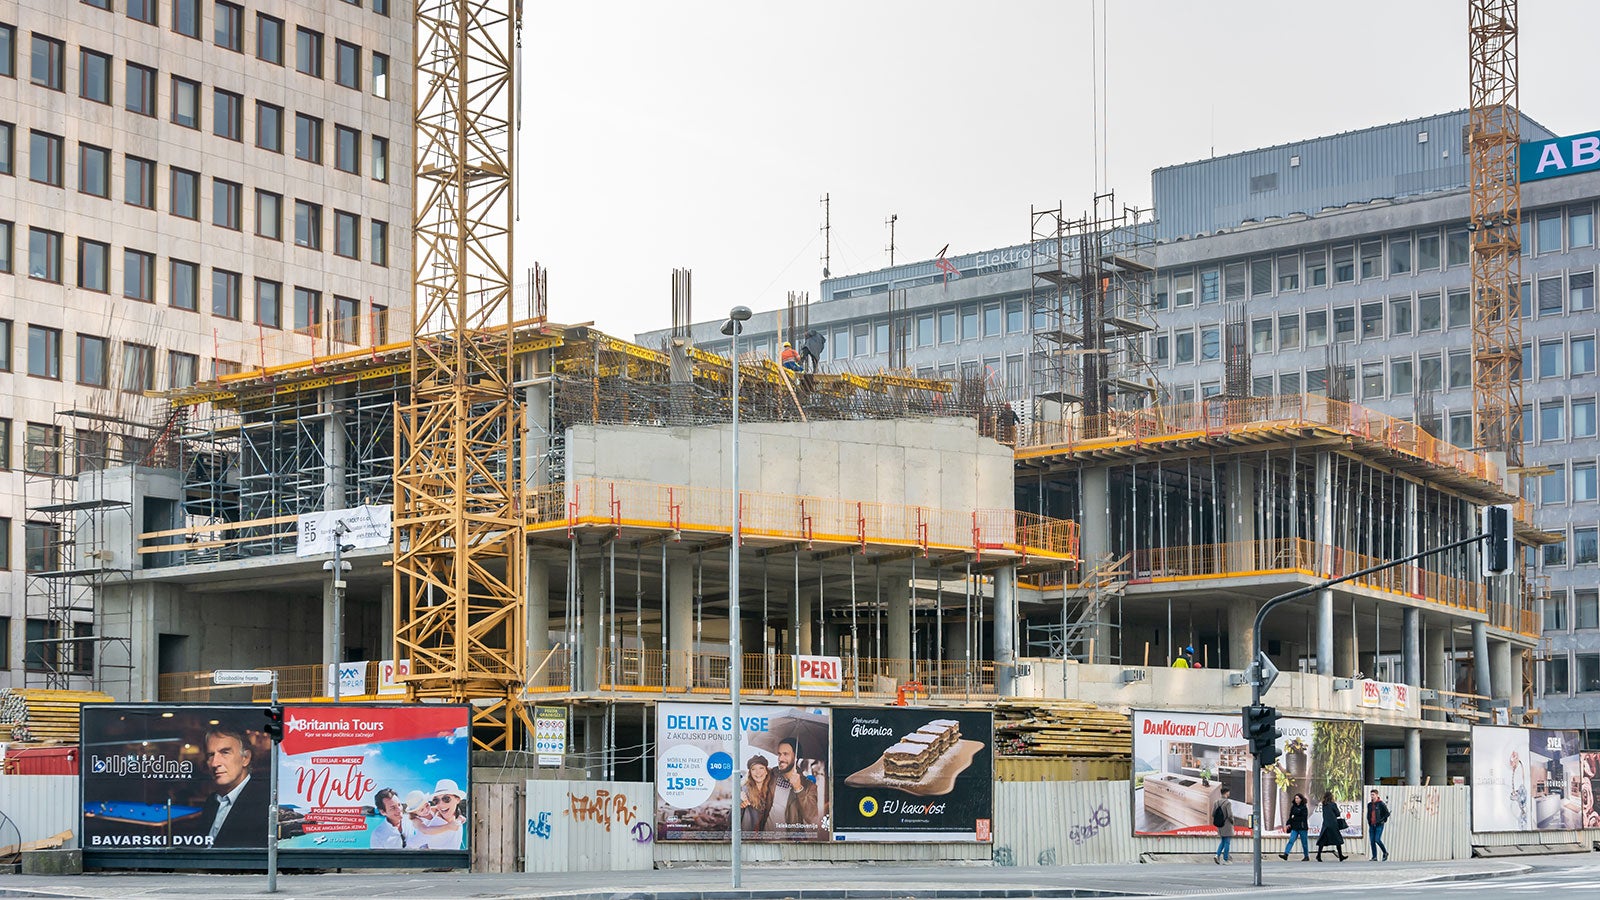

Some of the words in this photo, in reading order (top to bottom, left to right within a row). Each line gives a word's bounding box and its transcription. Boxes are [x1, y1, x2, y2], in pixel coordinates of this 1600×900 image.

[976, 248, 1031, 266] Elektro
[800, 660, 837, 679] PERI
[300, 719, 349, 730] Britannia
[352, 719, 384, 730] Tours
[667, 715, 718, 730] DELITA
[740, 717, 769, 732] VSE
[851, 724, 893, 737] Gibanica
[92, 755, 193, 776] biljardna
[295, 764, 377, 808] Malte
[883, 800, 899, 814] EU
[901, 801, 946, 815] kakovost
[1339, 805, 1358, 813] STENE
[92, 835, 167, 845] BAVARSKI
[173, 835, 214, 845] DVOR
